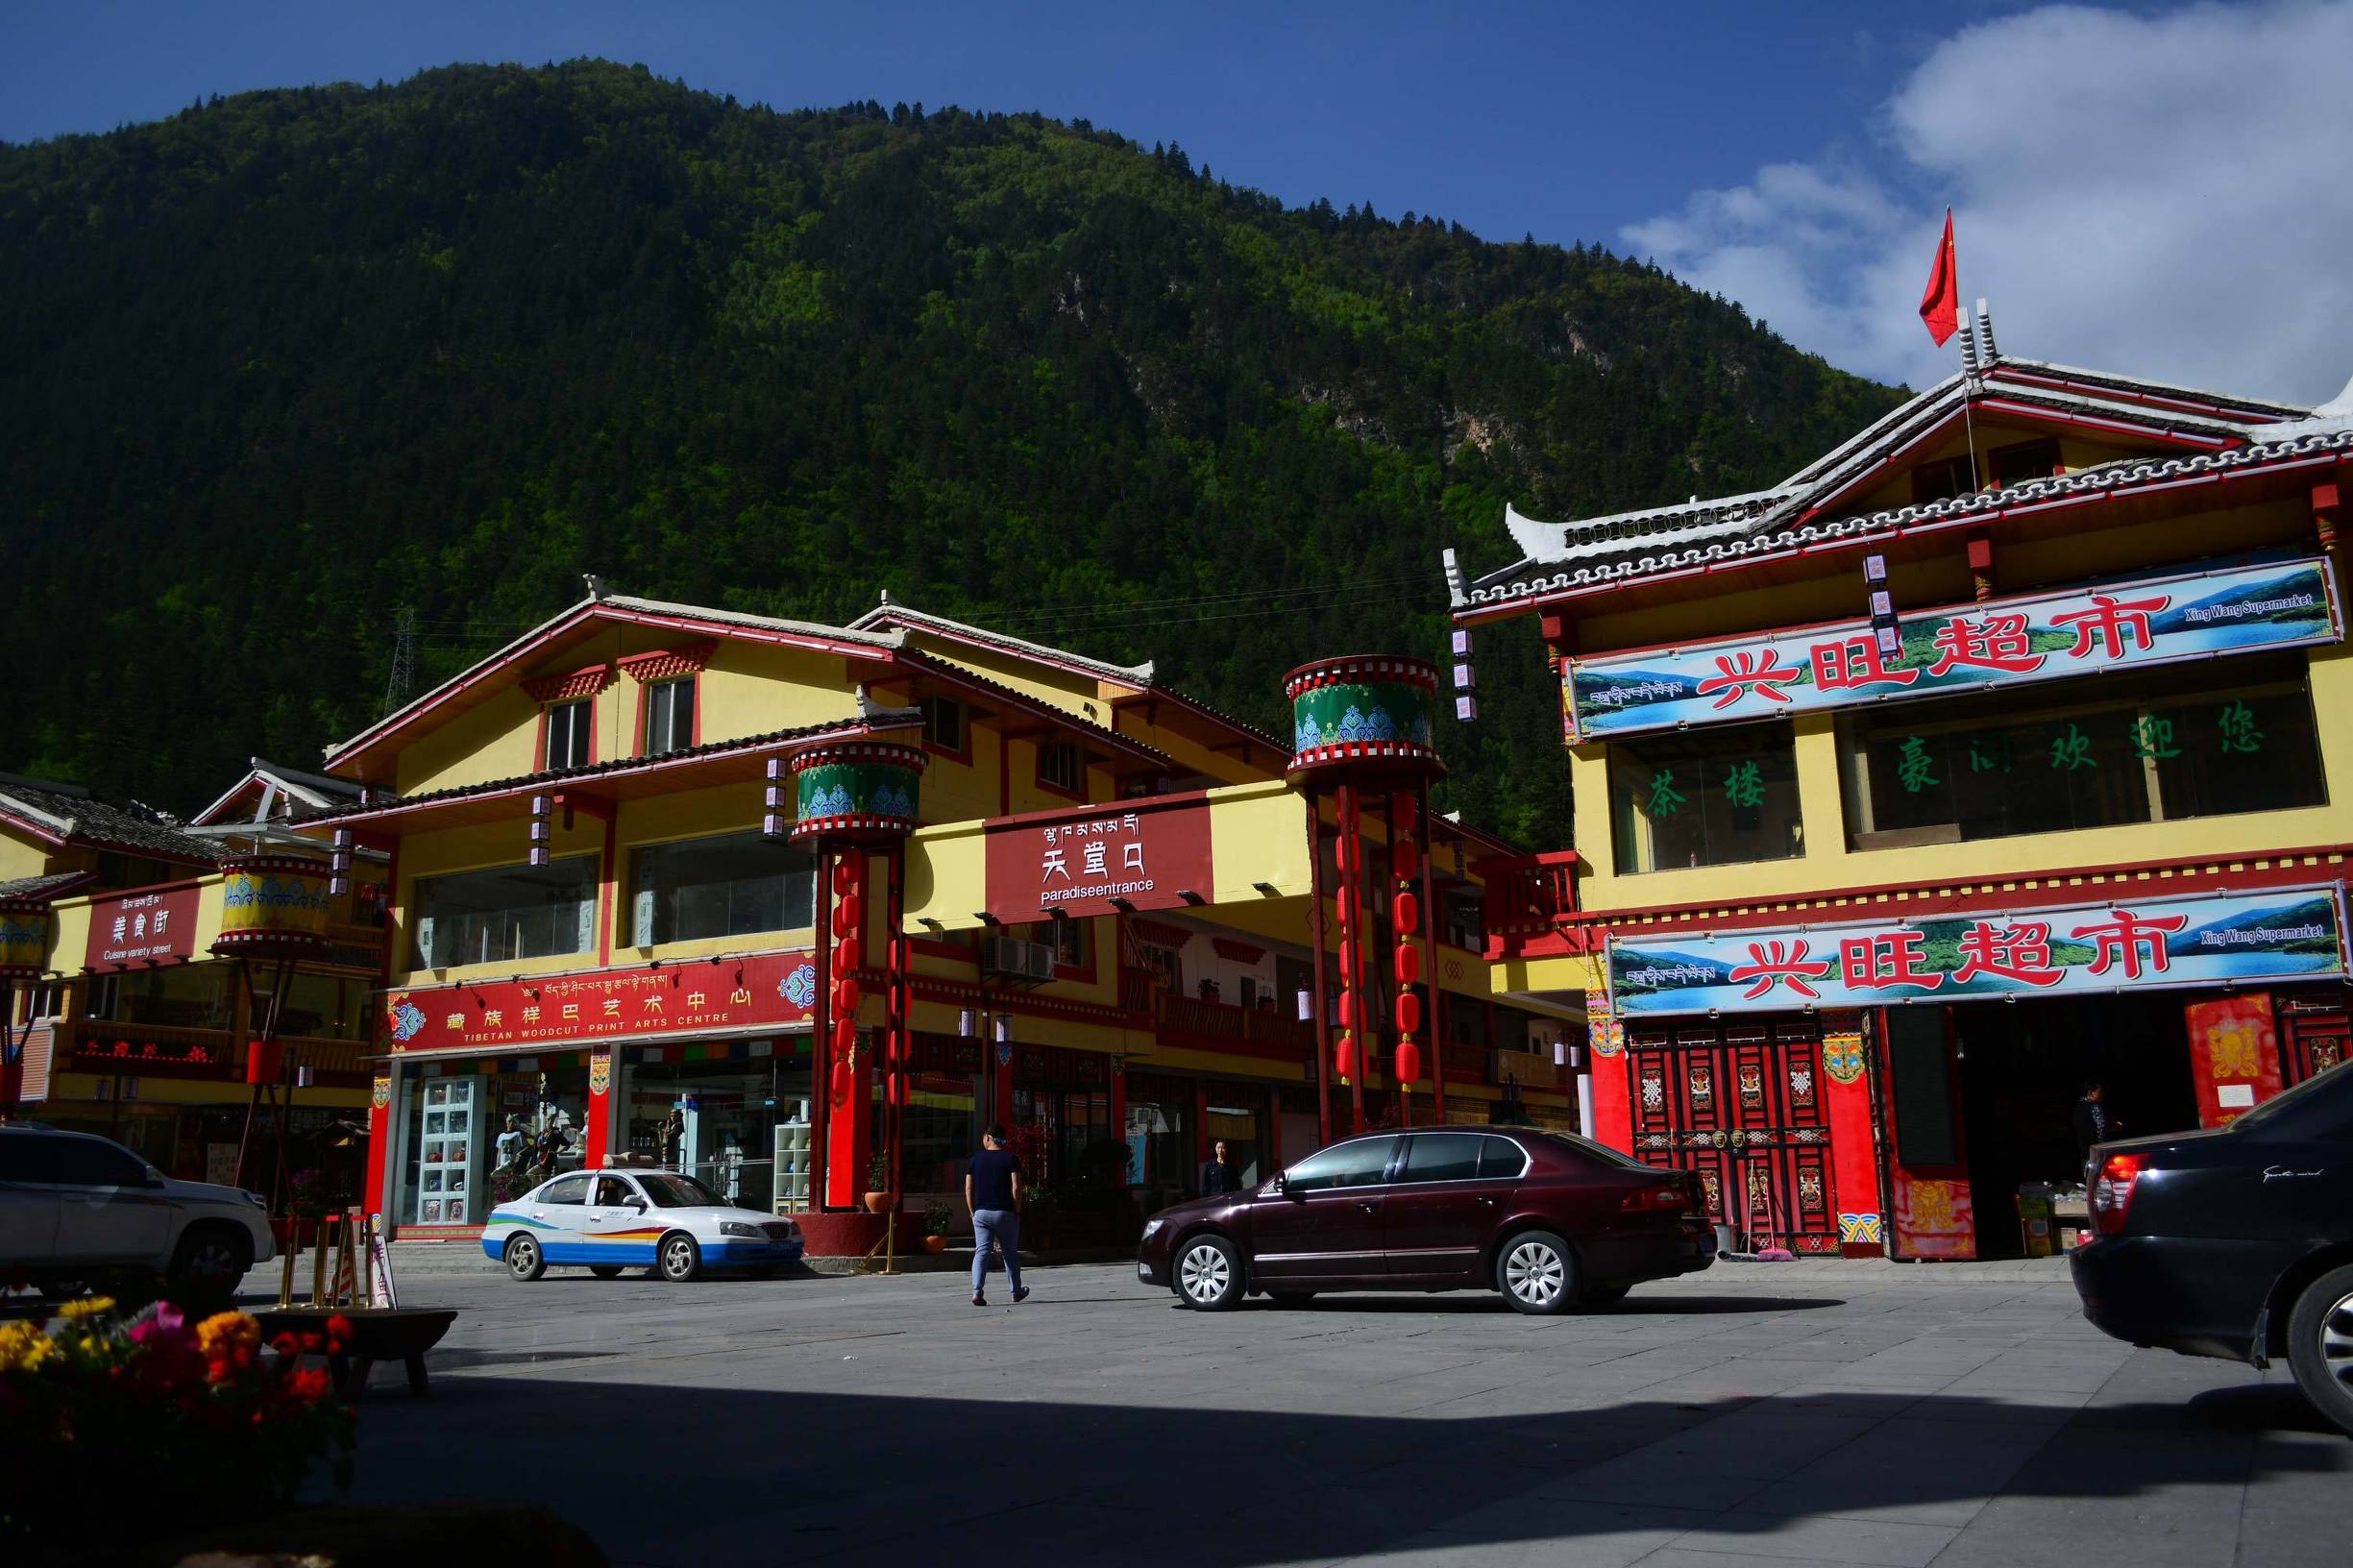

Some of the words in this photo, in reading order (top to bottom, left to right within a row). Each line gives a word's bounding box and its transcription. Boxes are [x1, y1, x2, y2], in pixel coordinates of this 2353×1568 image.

[2185, 608, 2212, 622] Xing
[2211, 604, 2243, 619] Wang
[2243, 594, 2313, 614] Supermarket
[1696, 595, 2171, 710] 兴旺超市
[1646, 760, 1766, 816] 茶楼
[1042, 841, 1146, 883] 天堂口
[112, 909, 170, 944] 美食街
[2201, 930, 2225, 945] Xing
[2224, 928, 2256, 944] Wang
[2256, 924, 2322, 943] Supermarket
[104, 949, 127, 960] Cuisine
[128, 946, 151, 958] variety
[153, 943, 172, 954] street
[1728, 909, 2188, 999] 兴旺超市
[447, 989, 751, 1031] 藏族祥巴艺术中心
[464, 1030, 513, 1042] TIBETAN
[521, 1025, 579, 1038] WOODCUT
[589, 1021, 625, 1033] PRINT
[635, 1017, 668, 1028] ARTS
[677, 1013, 729, 1025] CENTRE
